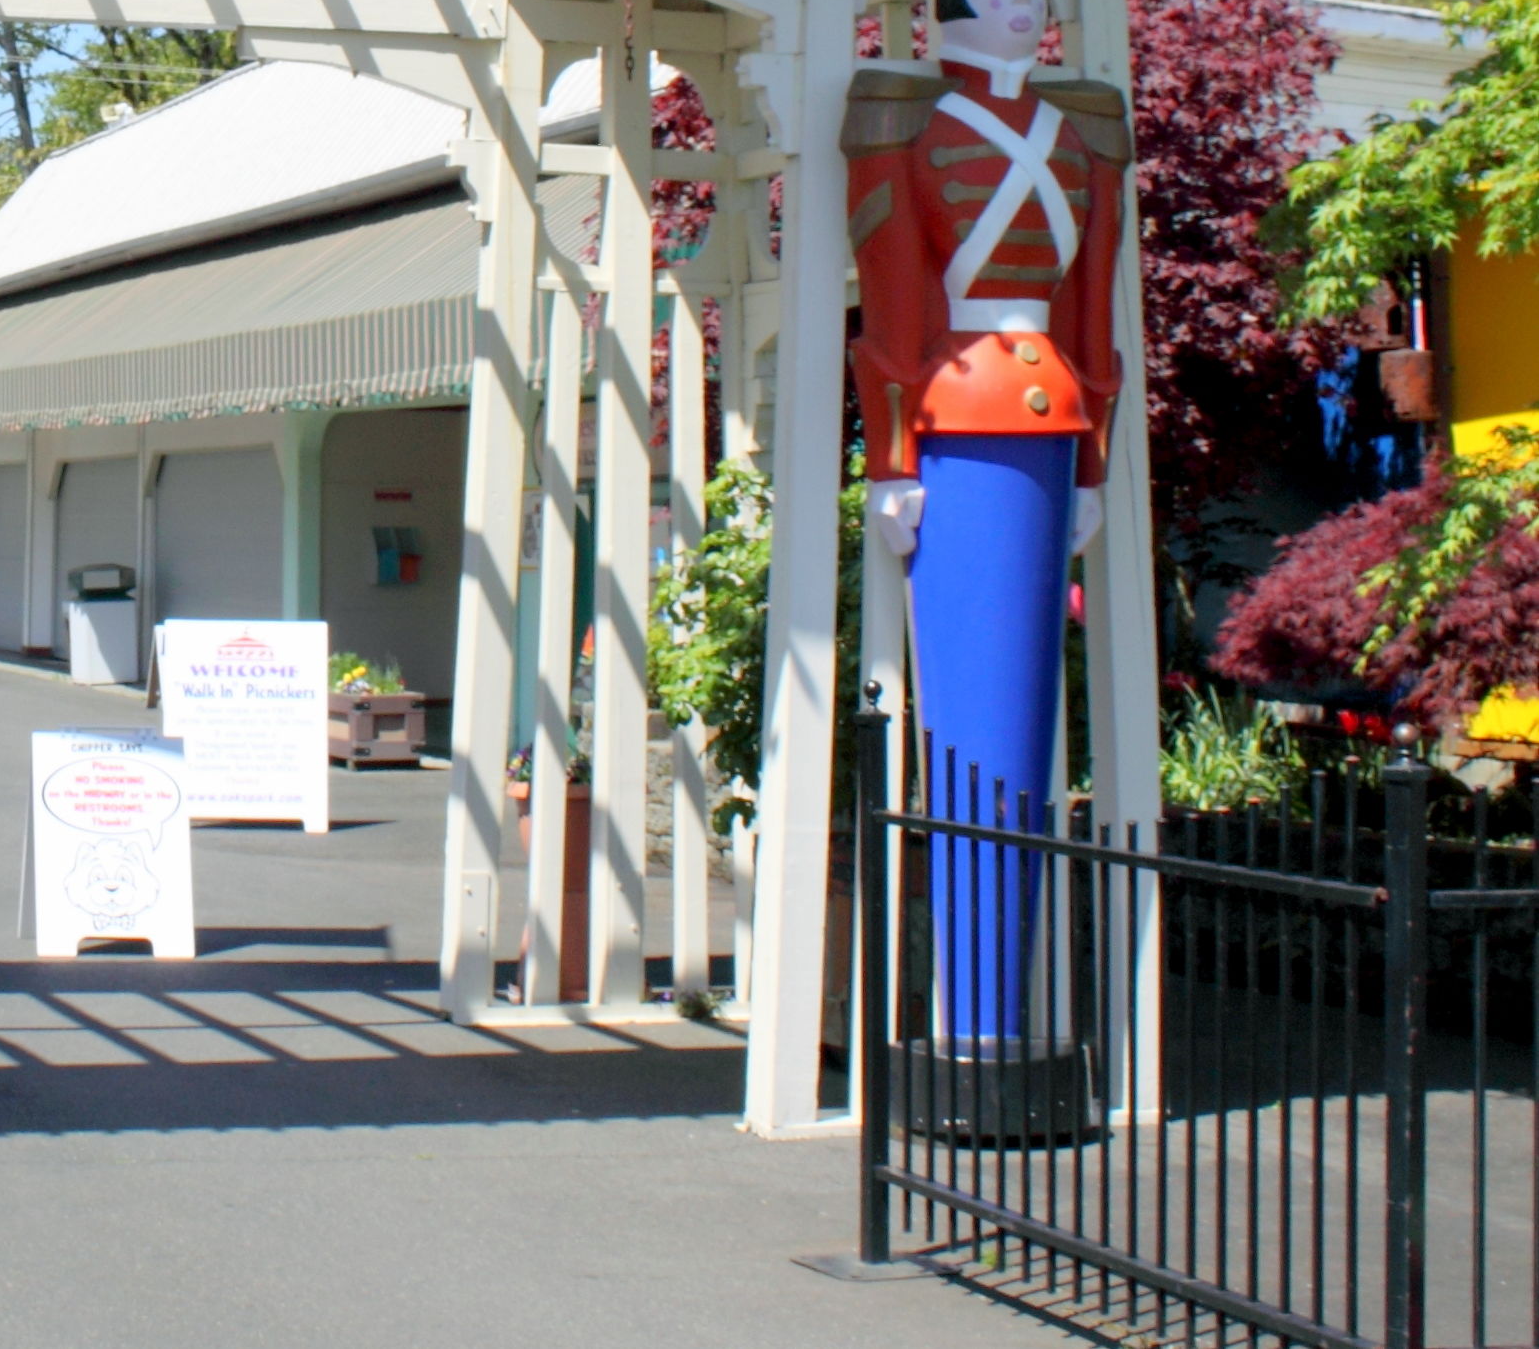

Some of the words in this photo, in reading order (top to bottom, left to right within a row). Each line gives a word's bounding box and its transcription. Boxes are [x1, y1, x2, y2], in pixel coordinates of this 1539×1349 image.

[189, 664, 299, 679] WELCOME
[245, 681, 316, 700] Picnickers
[71, 743, 112, 753] CHIPPER
[75, 776, 89, 785] NO
[95, 776, 145, 785] SMOKING
[64, 790, 79, 798] the
[157, 790, 172, 799] the
